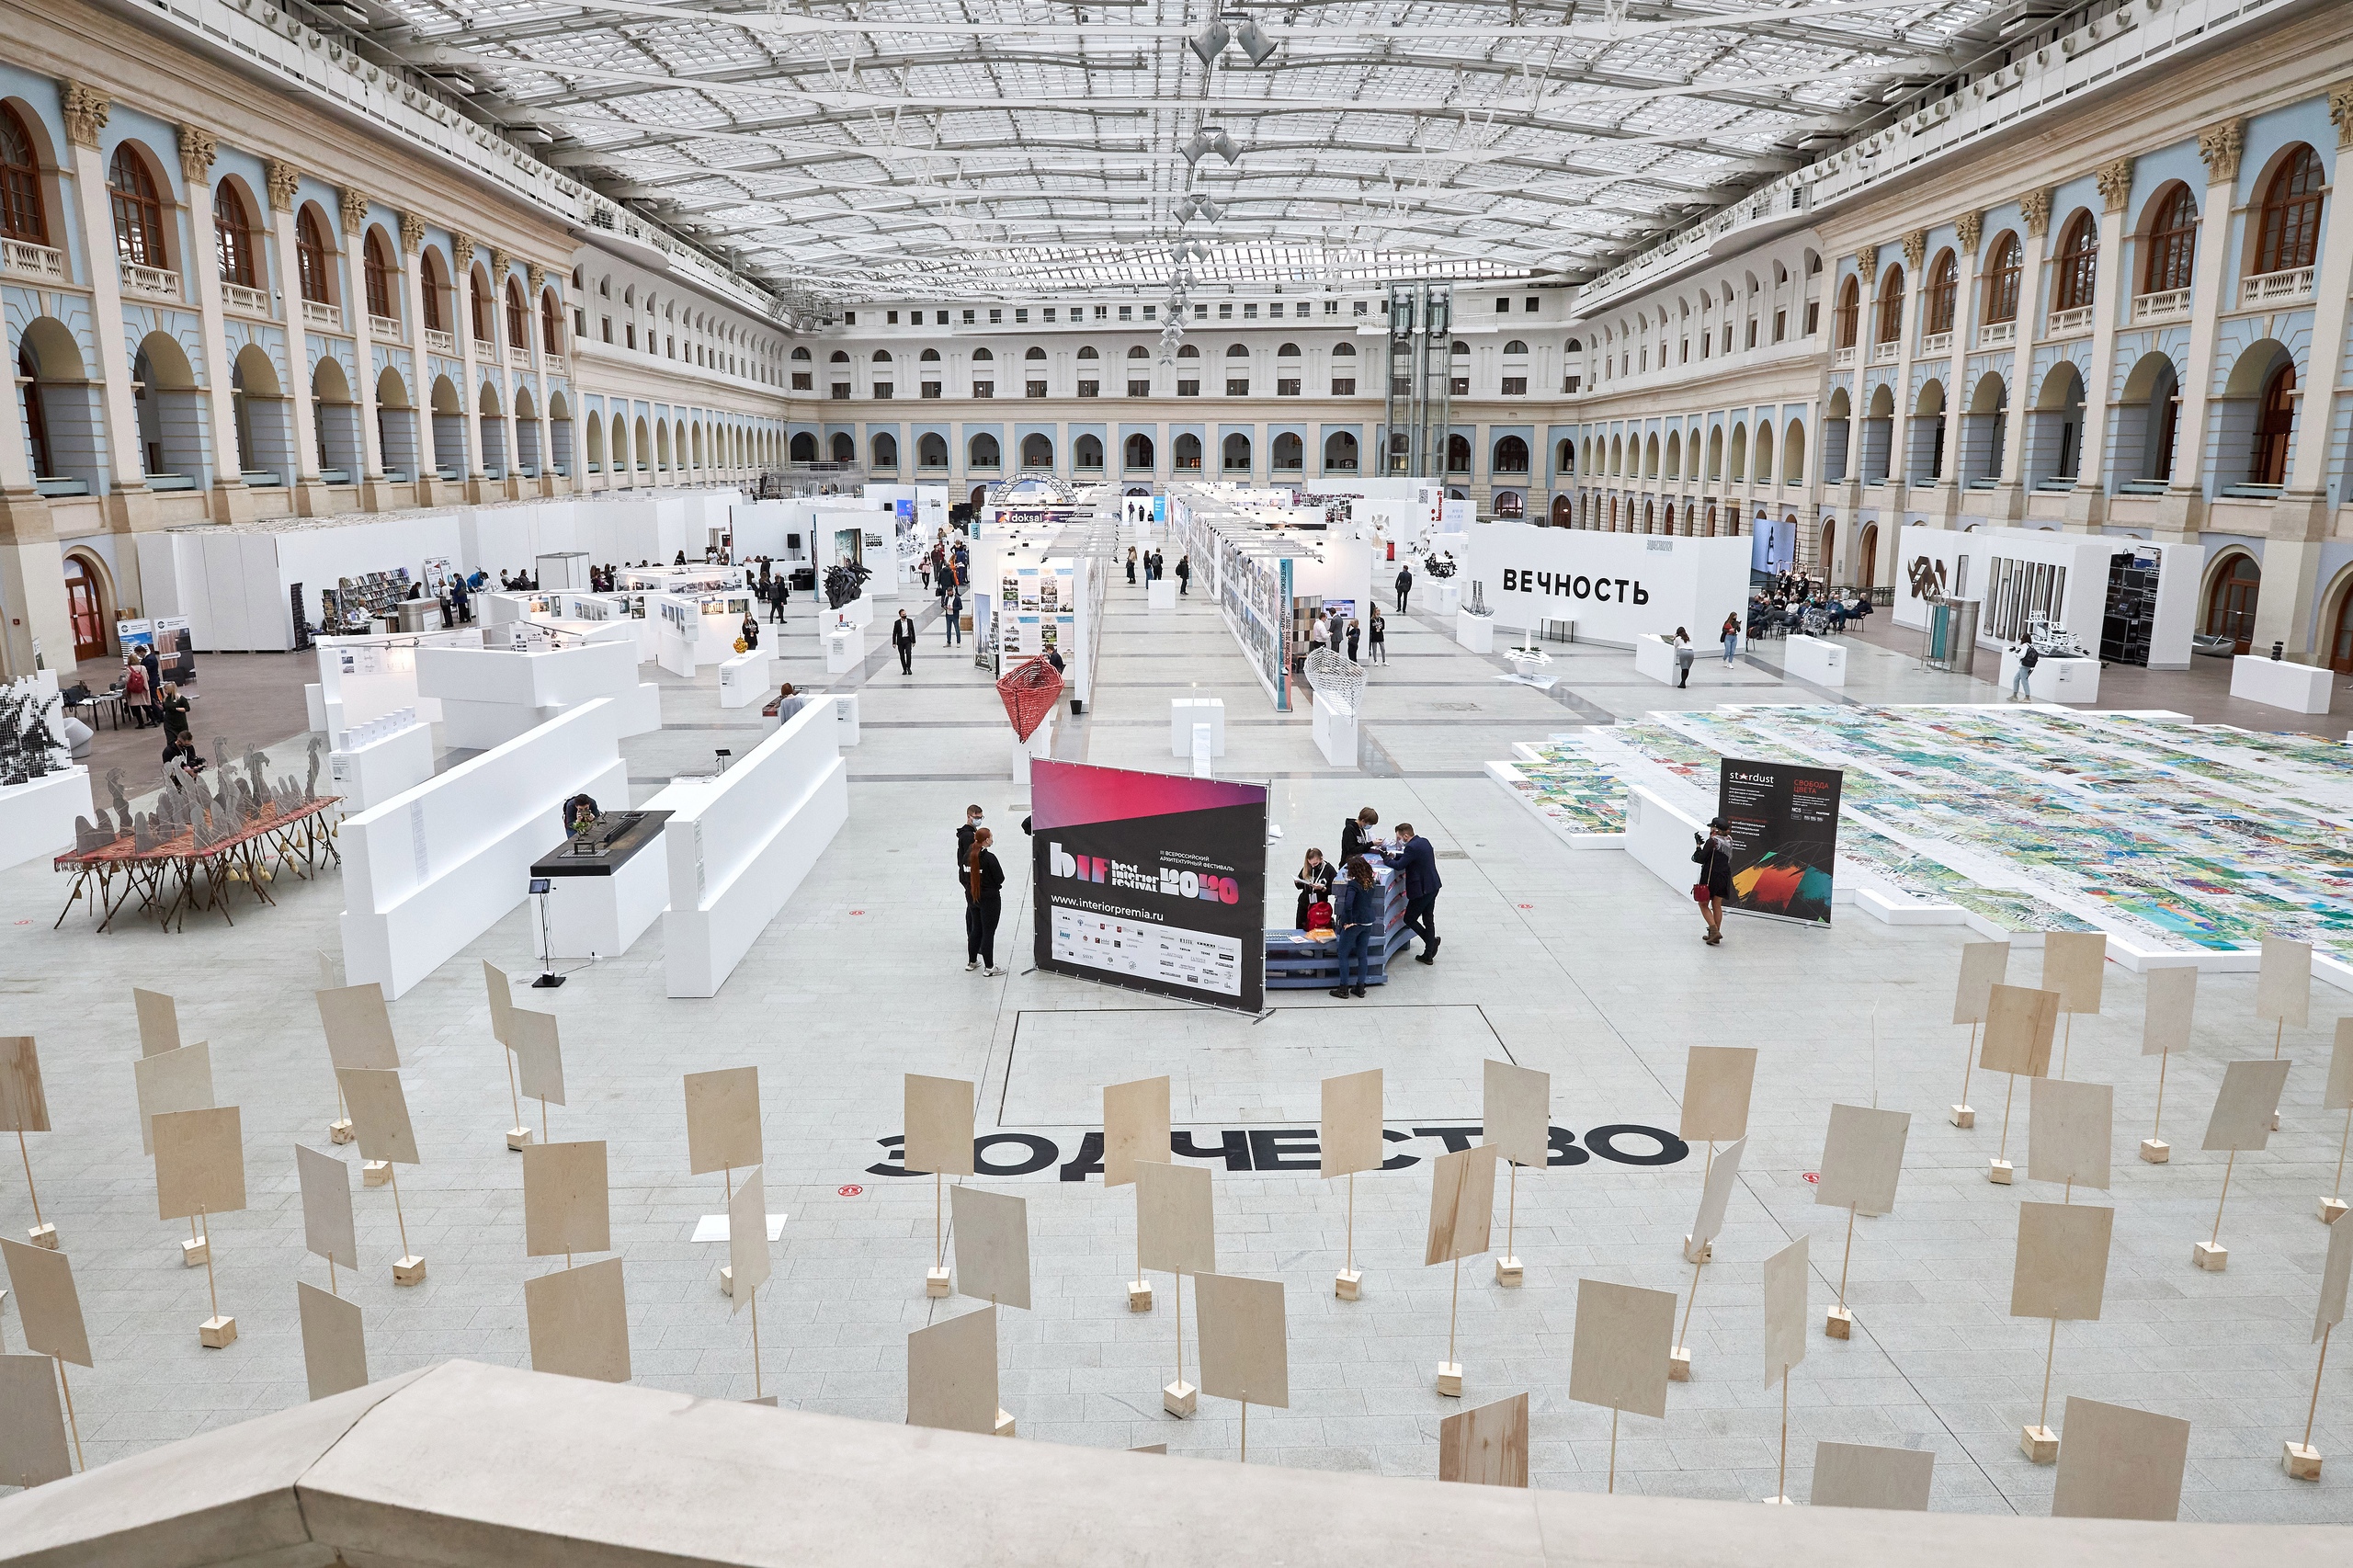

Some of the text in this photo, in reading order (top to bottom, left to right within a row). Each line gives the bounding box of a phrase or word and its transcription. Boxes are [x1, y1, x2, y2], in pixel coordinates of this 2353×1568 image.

[1011, 514, 1043, 522] doksal
[1503, 568, 1649, 605] ВЕЧНОСТЬ
[1793, 779, 1829, 789] СВОБОДА
[1165, 850, 1210, 861] ВСЕРОССИЙСКИЙ
[1111, 859, 1139, 874] best
[1159, 856, 1235, 872] АРХИТЕКТУРНЫЙ ФЕСТИВАЛЬ
[1160, 867, 1239, 905] 2020
[1051, 894, 1164, 921] www.interiorpremia.ru
